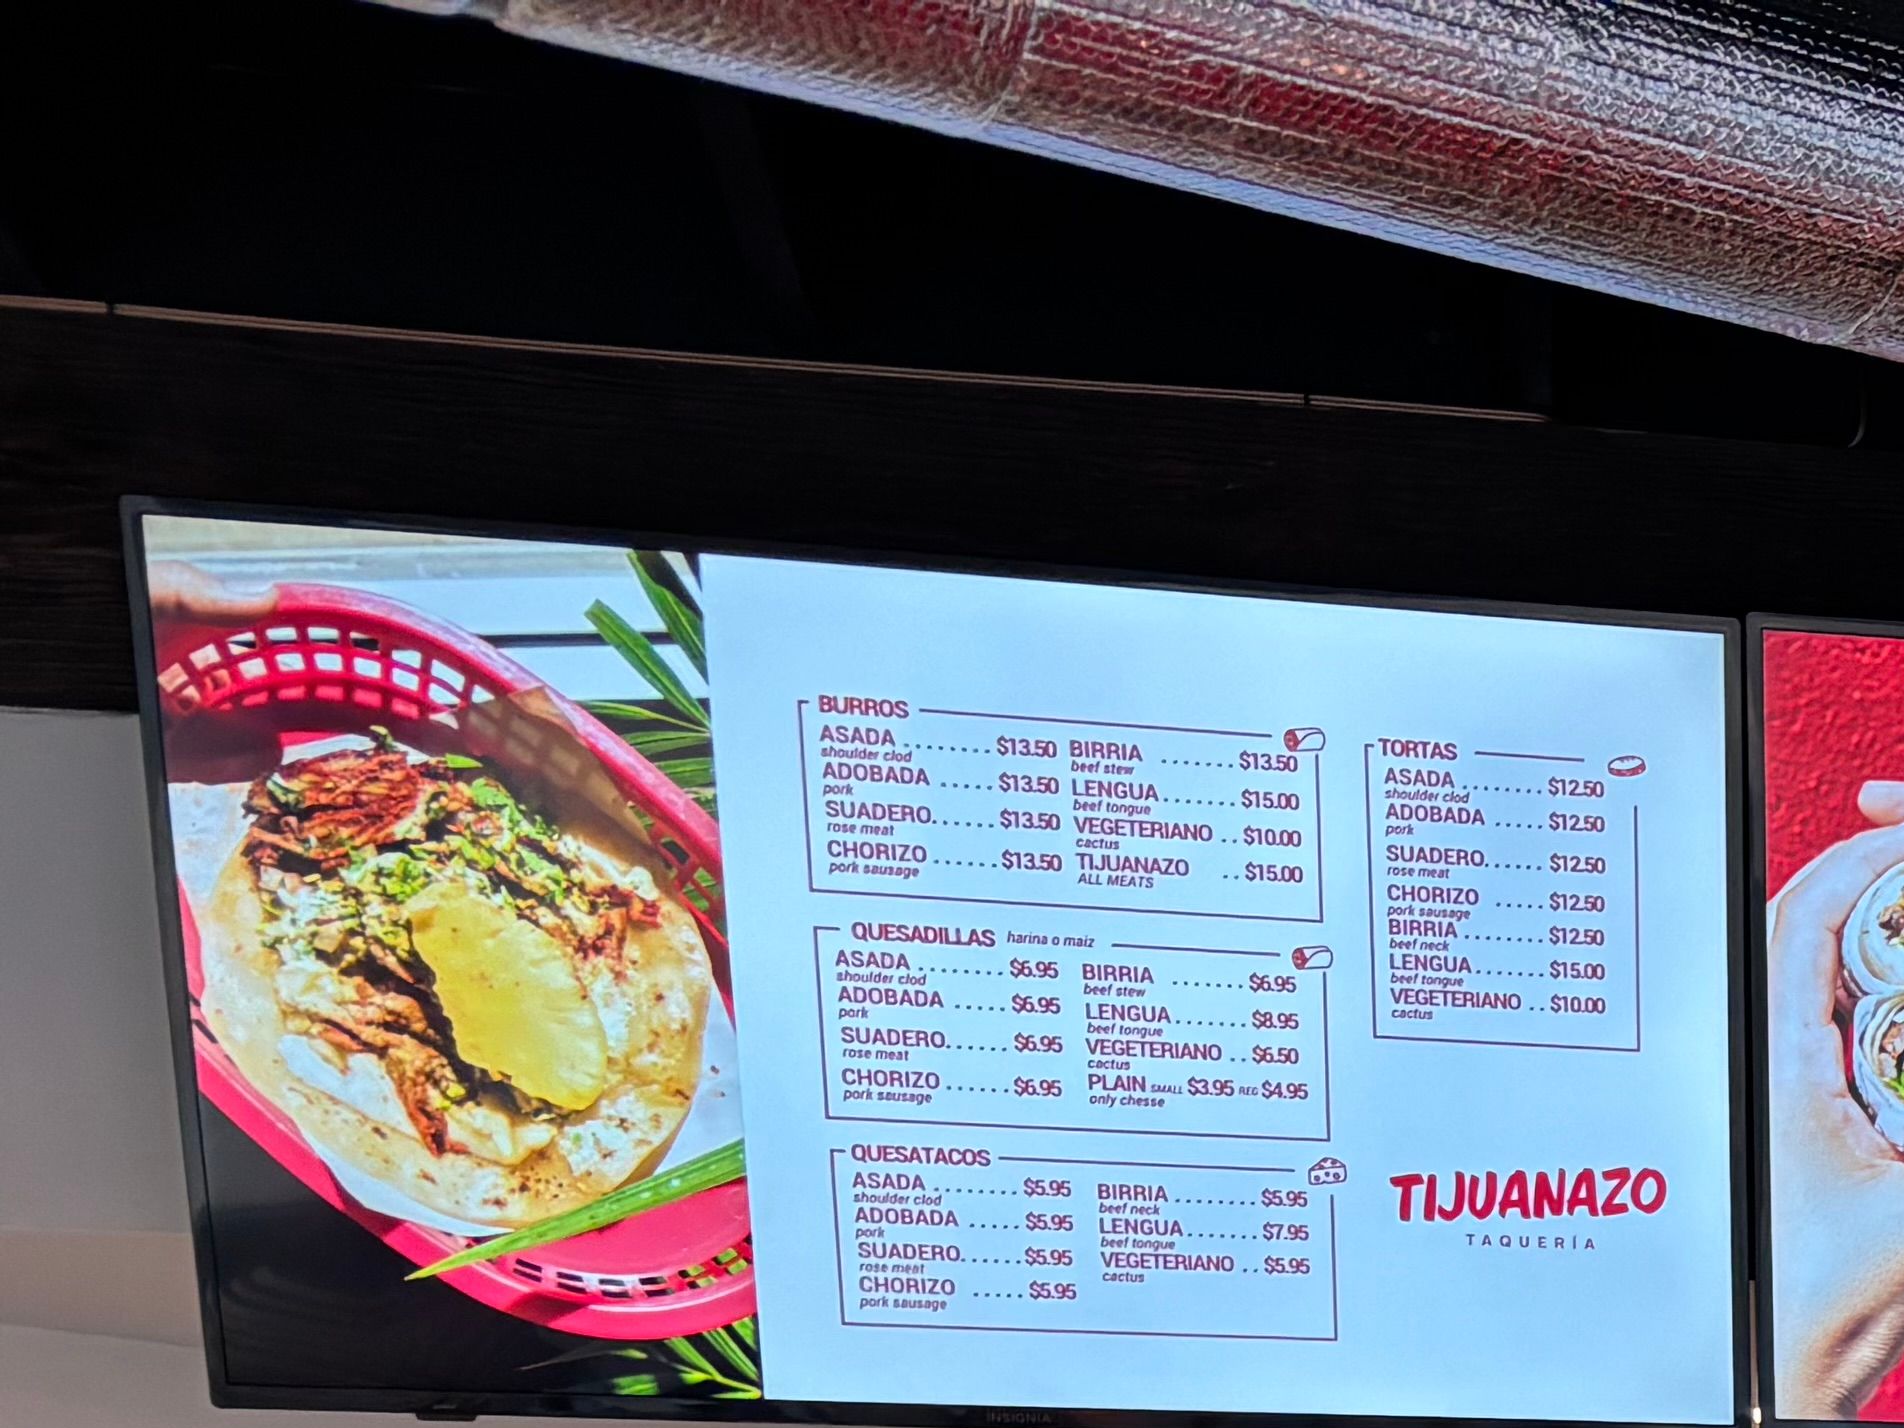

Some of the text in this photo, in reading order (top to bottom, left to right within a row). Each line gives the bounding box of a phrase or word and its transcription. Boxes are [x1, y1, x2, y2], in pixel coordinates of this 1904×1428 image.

[818, 695, 909, 719] BURROS
[820, 724, 1057, 759] ASADA $13.50
[821, 747, 912, 762] shoulder clod
[1378, 738, 1457, 760] TORTAS
[1069, 740, 1298, 772] BIRRIA $13.50
[822, 762, 1060, 794] ADOBADA $13.50
[823, 785, 853, 797] pork
[1072, 778, 1300, 810] LENGUA $15.00
[1000, 808, 1061, 831] $13.50
[1073, 799, 1151, 817] beef tongue
[1386, 803, 1605, 833] ADOBADA $12.50
[1073, 816, 1302, 847] VEGETERIANO $10.00
[827, 839, 1063, 872] CHORIZO $13.50
[1075, 852, 1303, 883] TIJUANAZO $15.00
[1078, 873, 1154, 888] ALL MEATS
[1387, 884, 1605, 912] CHORIZO $12.50
[851, 921, 996, 947] QUESADILLAS
[1007, 931, 1048, 944] harina
[1052, 936, 1060, 945] o
[1388, 918, 1604, 946] BIRRIA $12.50
[835, 949, 1059, 979] ASADA $6.95
[1082, 963, 1297, 993] BIRRIA $6.95
[1083, 983, 1146, 997] beef stew
[1390, 988, 1606, 1014] VEGETERIANO $10.00
[1085, 1002, 1299, 1030] LENGUA $8.95
[1085, 1038, 1299, 1064] VEGETERIANO $6.50
[1088, 1073, 1146, 1093] PLAIN
[1187, 1076, 1235, 1096] $3.95
[1262, 1080, 1308, 1100] $4.95
[1089, 1093, 1165, 1108] only chesse
[851, 1143, 991, 1167] QUESATACOS
[1098, 1183, 1308, 1208] BIRRIA $5.95
[1389, 1167, 1667, 1222] TIJUANAZO
[1099, 1202, 1127, 1214] beef
[1100, 1218, 1310, 1242] LENGUA $7.95
[1466, 1233, 1595, 1249] TAQUERÍA
[858, 1276, 1077, 1301] CHORIZO $5.95
